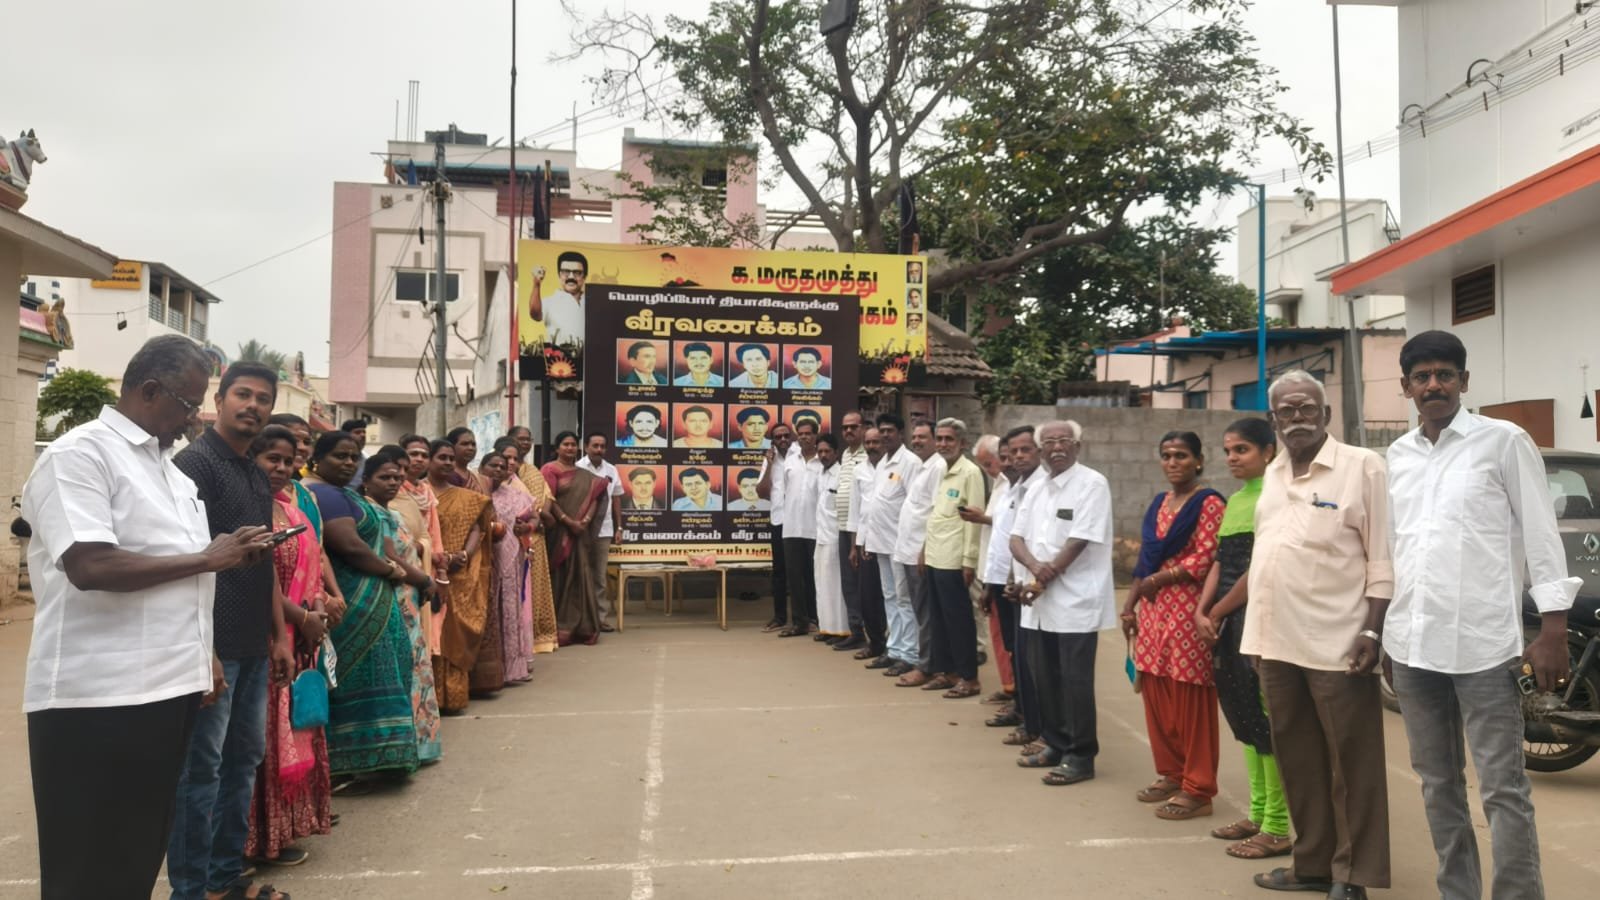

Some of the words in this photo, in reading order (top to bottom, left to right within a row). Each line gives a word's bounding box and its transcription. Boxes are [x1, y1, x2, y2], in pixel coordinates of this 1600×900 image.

[731, 264, 878, 298] க.மருதமுத்து
[608, 291, 718, 306] மொழிப்போர்
[719, 295, 840, 311] தியாகிகளுக்கு
[860, 296, 898, 325] கம்
[625, 308, 823, 337] வீரவணக்கம்
[643, 529, 722, 540] வணக்கம்
[731, 529, 754, 541] வீர
